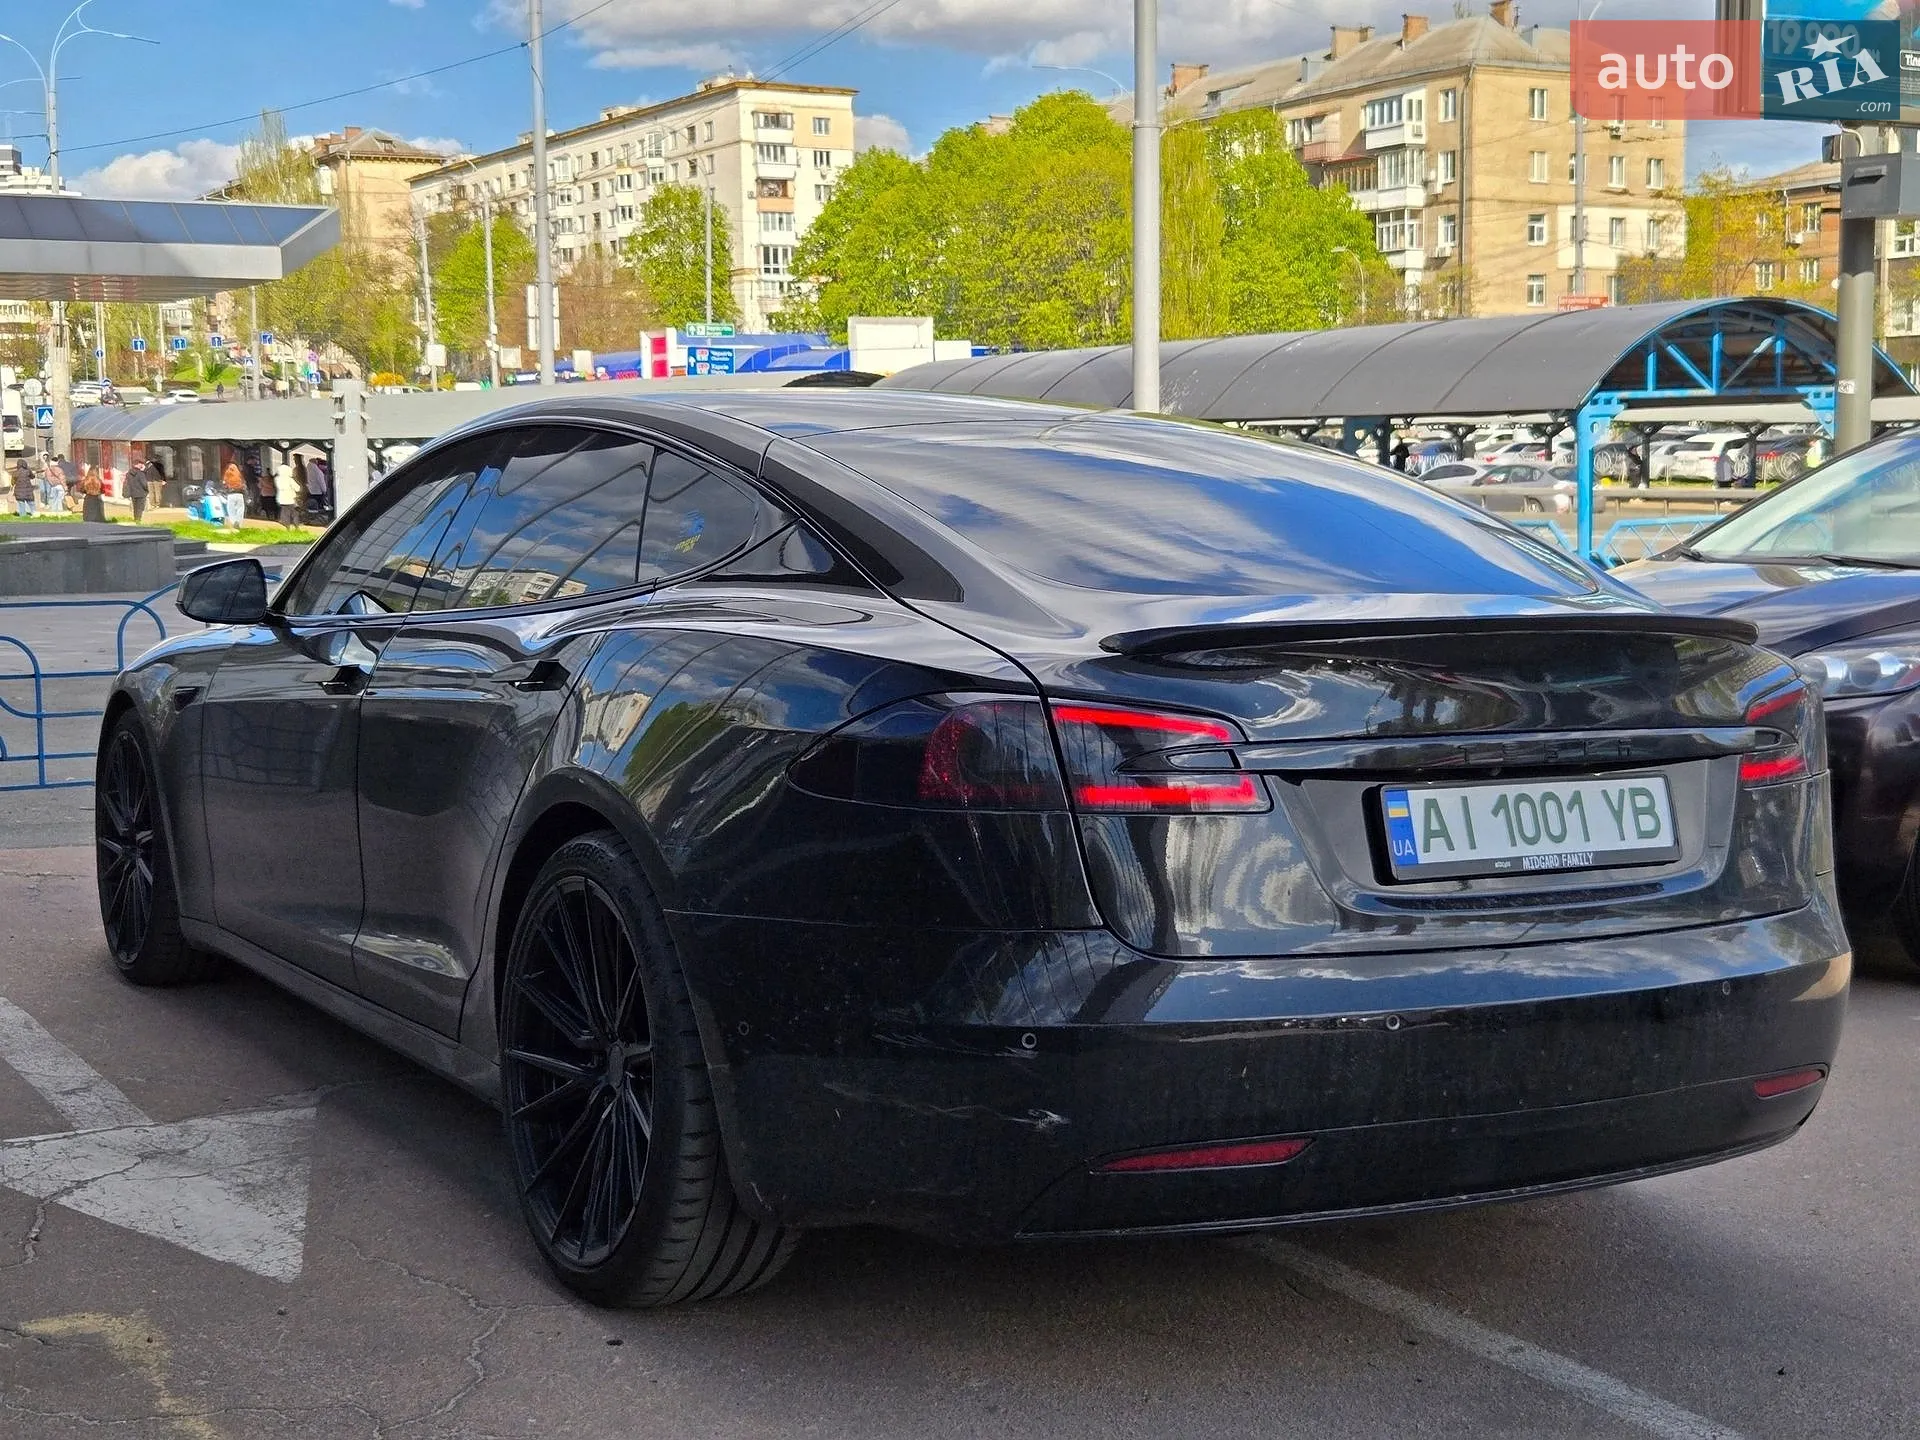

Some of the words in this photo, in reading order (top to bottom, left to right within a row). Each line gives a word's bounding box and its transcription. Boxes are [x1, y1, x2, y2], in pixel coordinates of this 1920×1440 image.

[1422, 795, 1477, 853] AI
[1491, 789, 1591, 847] 1001
[1601, 787, 1661, 841] YB
[1393, 839, 1415, 857] UA
[1522, 856, 1560, 870] MIDGARD
[1561, 852, 1594, 867] FAMILY
